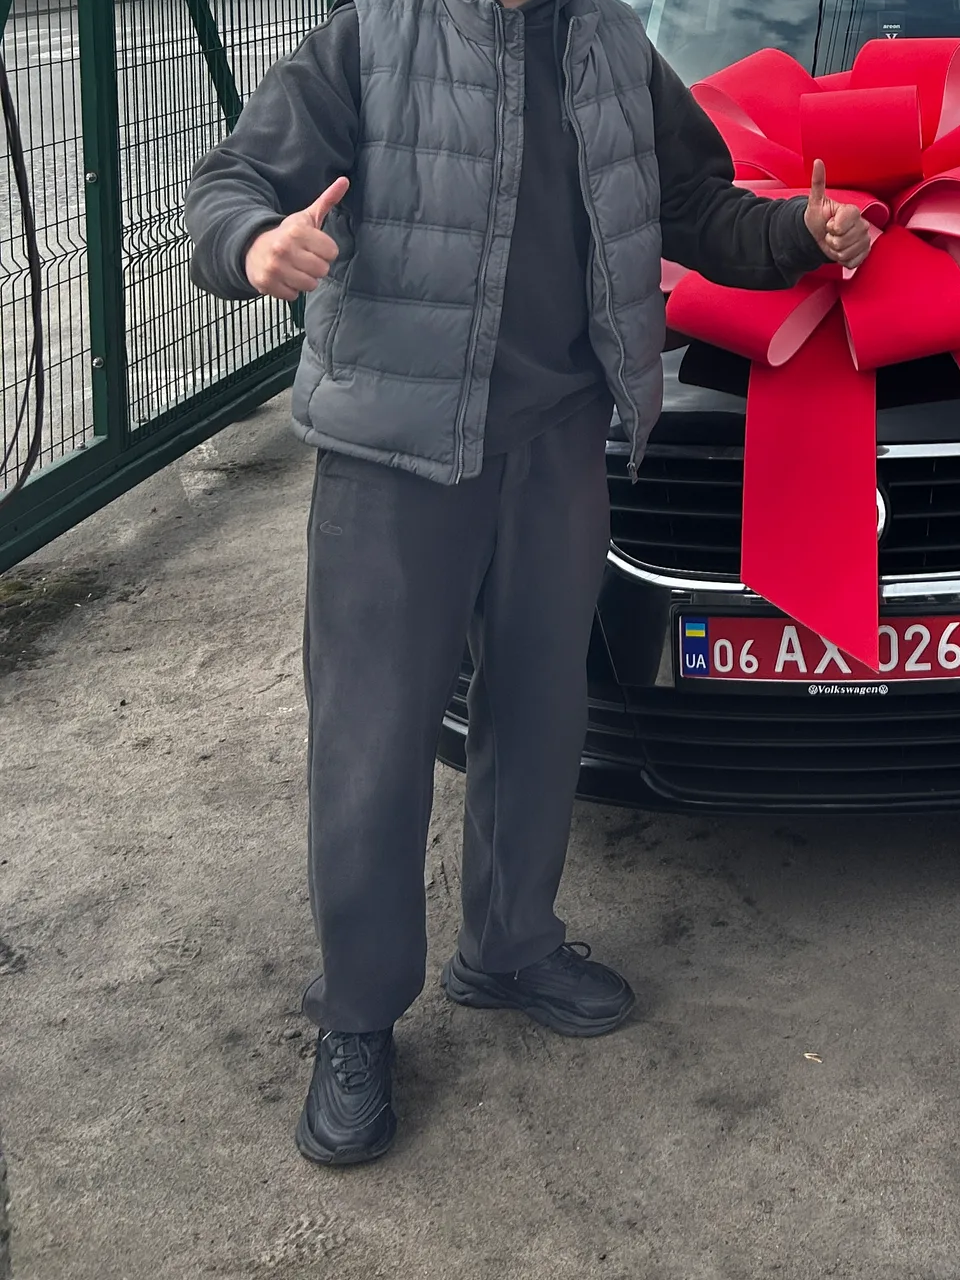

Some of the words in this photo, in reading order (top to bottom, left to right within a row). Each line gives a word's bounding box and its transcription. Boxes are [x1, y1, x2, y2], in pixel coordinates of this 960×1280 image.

[713, 638, 759, 674] 06
[774, 625, 852, 674] AX
[685, 653, 707, 669] UA
[818, 684, 878, 696] Volkswagen
